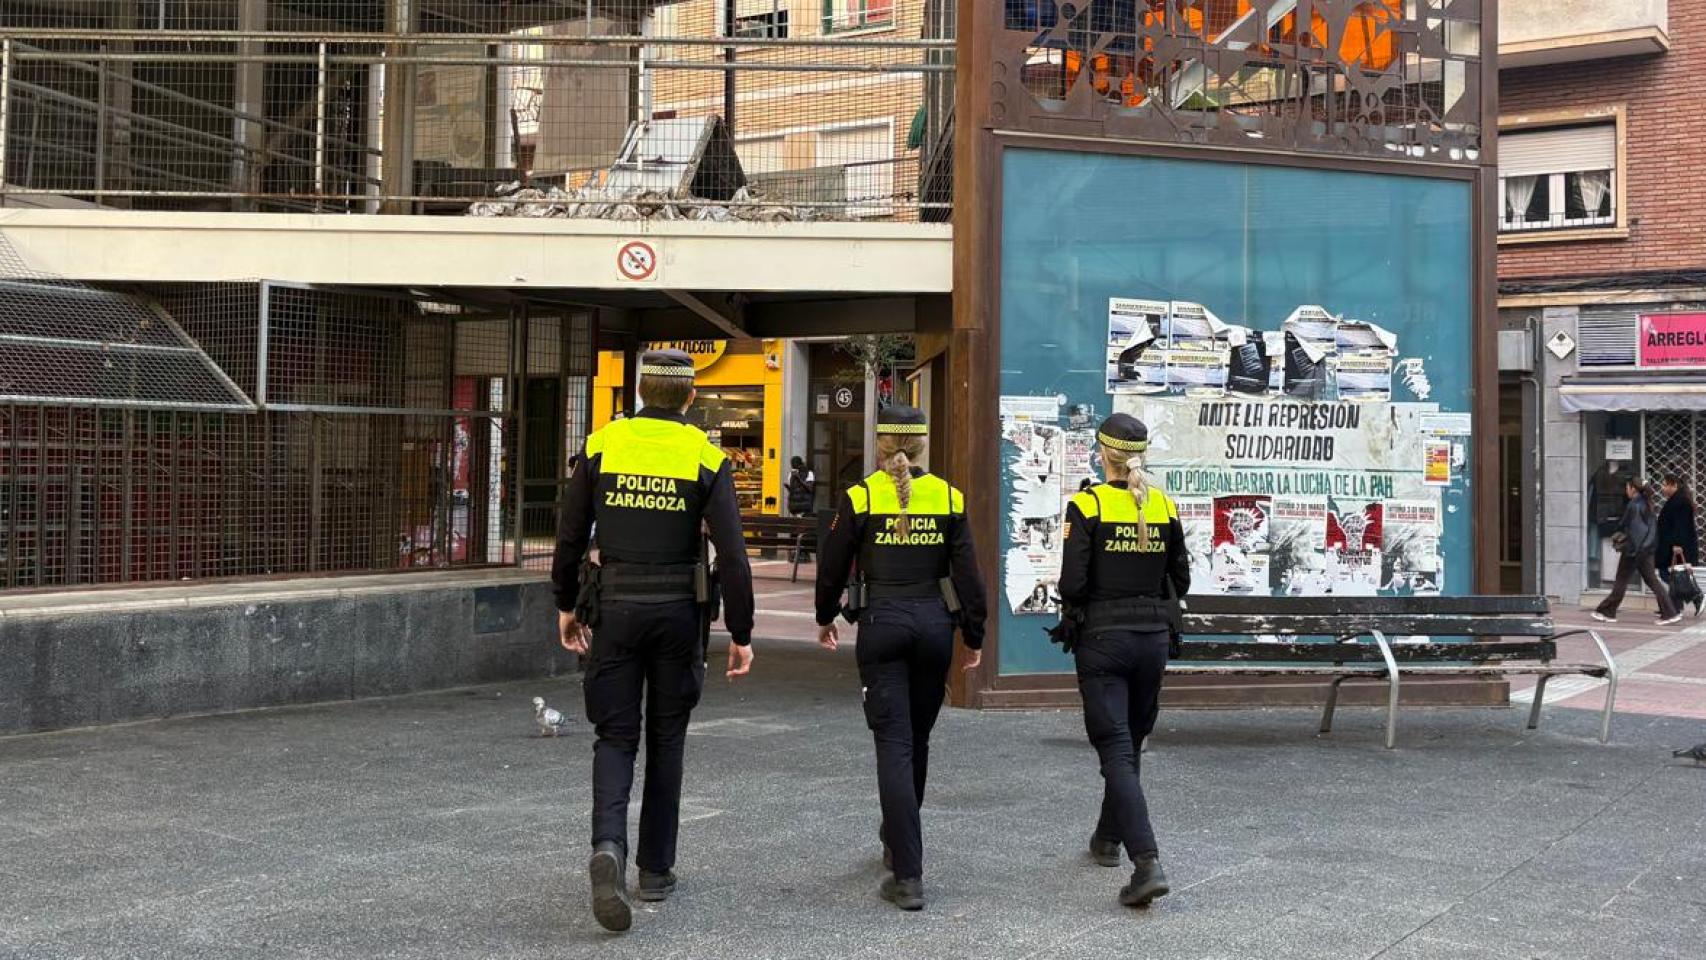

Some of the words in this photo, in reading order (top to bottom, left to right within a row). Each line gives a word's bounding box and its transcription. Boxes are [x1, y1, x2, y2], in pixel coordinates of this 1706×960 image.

[1648, 332, 1706, 347] ARREGL
[839, 392, 850, 403] 45
[1198, 403, 1241, 427] ANTE
[1244, 403, 1264, 428] LA
[1268, 403, 1361, 430] REPRESION
[1225, 433, 1335, 461] SOLIDARIDAD
[616, 474, 677, 494] POLICIA
[1166, 470, 1183, 492] NO
[1236, 471, 1274, 494] PARAR
[1277, 471, 1291, 495] LA
[1294, 472, 1332, 495] LUCHA
[1335, 473, 1350, 496] DE
[1353, 473, 1366, 496] LA
[1370, 474, 1394, 498] PAH
[605, 491, 687, 512] ZARAGOZA
[885, 517, 937, 531] PICIA
[1115, 526, 1161, 539] POLIA
